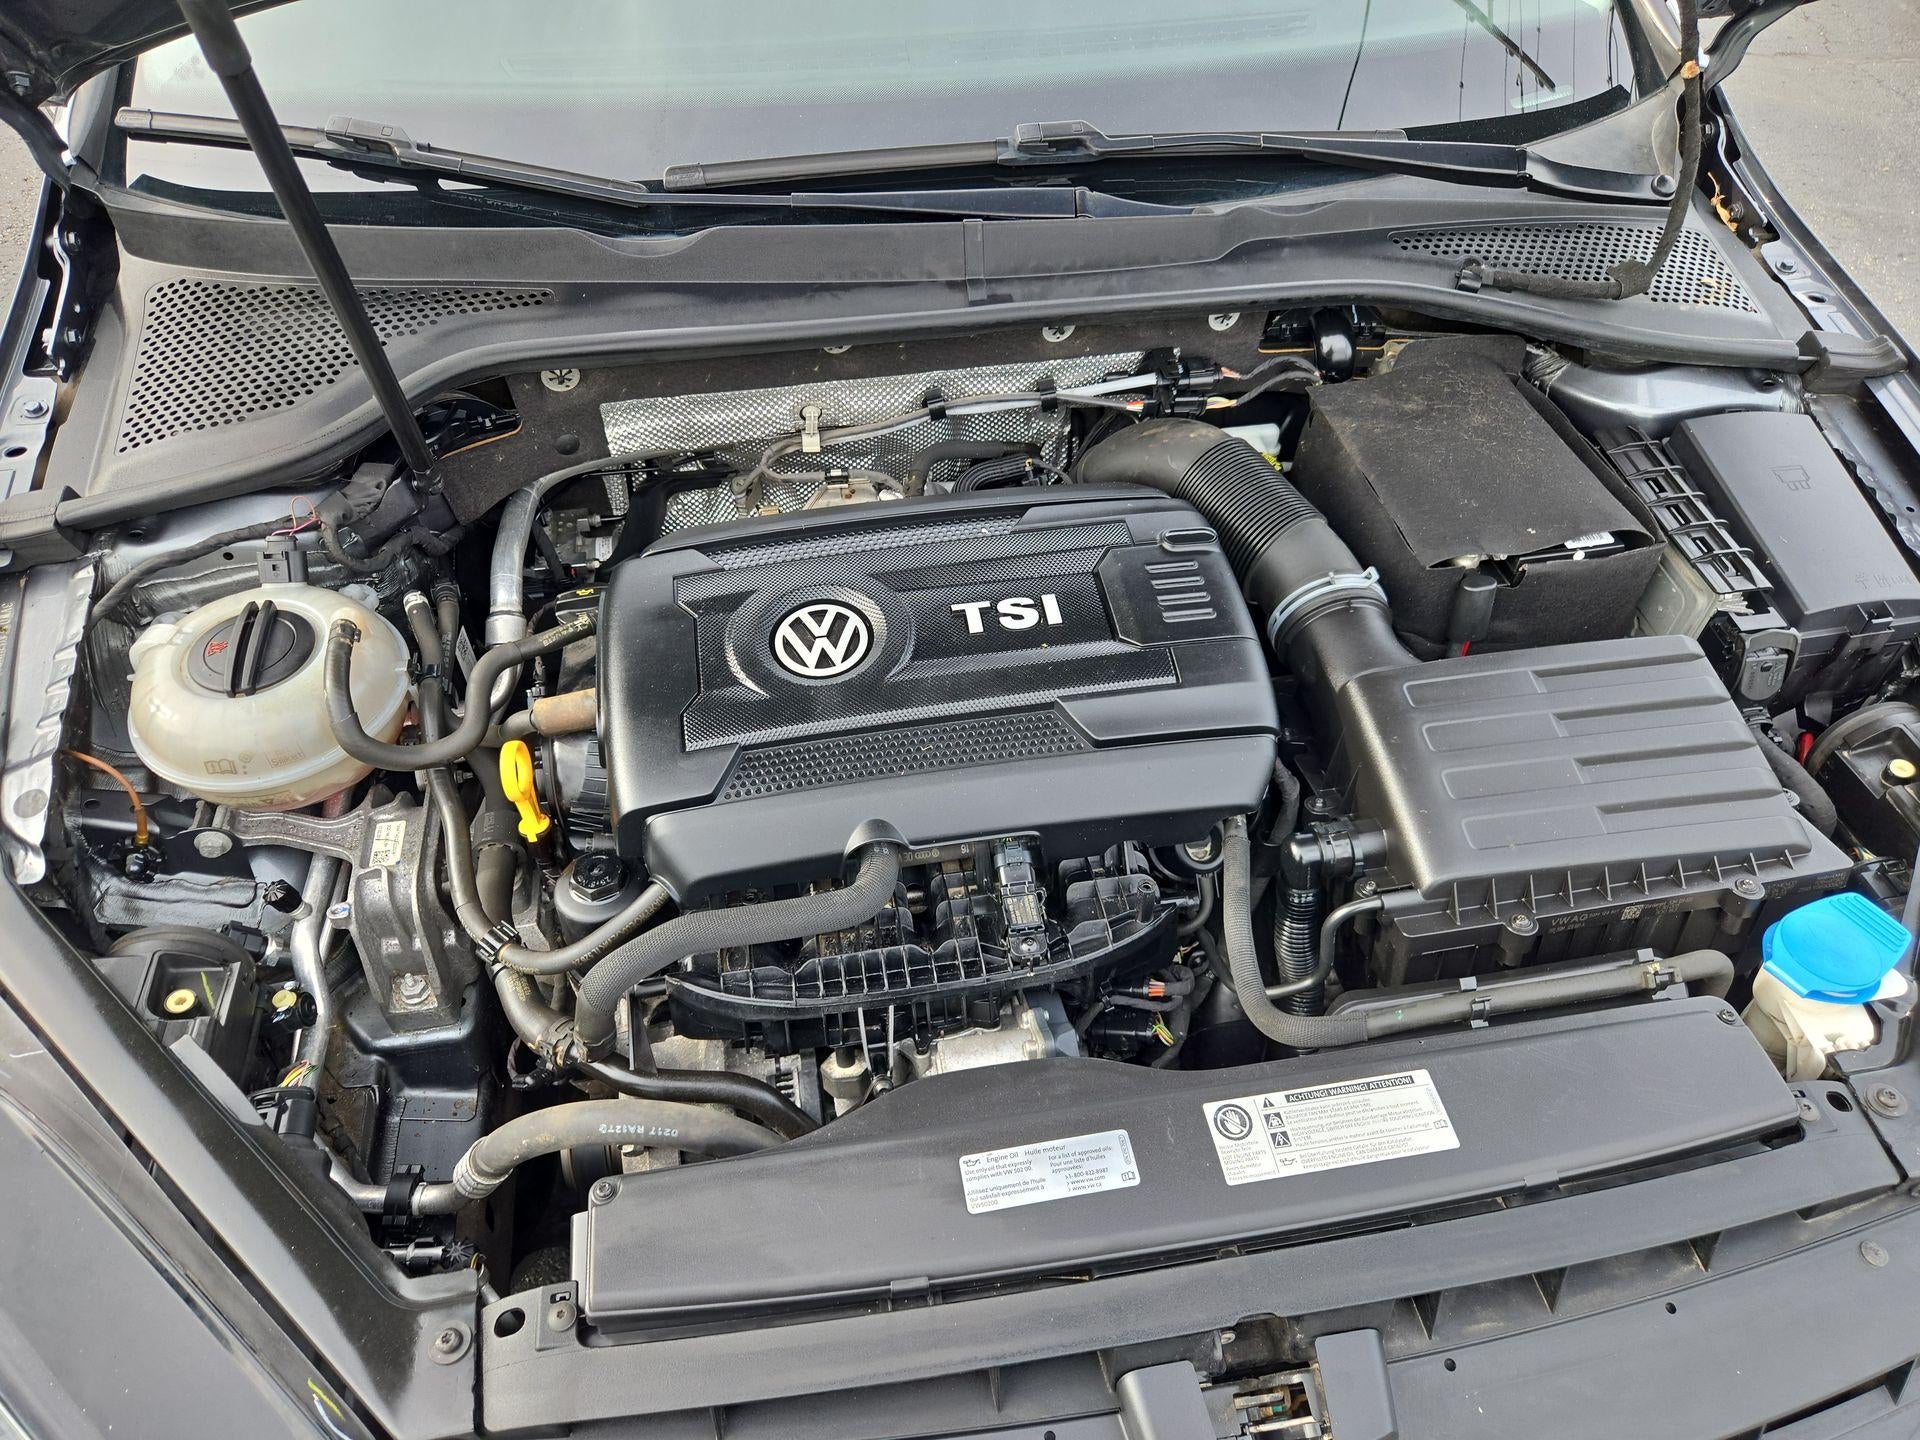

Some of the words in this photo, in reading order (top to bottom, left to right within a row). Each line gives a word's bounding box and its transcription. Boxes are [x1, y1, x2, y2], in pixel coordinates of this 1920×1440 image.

[951, 594, 1063, 634] TSI
[1288, 1089, 1327, 1101] ACHTUNG!
[1328, 1083, 1368, 1095] WARNING!
[1368, 1076, 1411, 1089] ATTENTION!
[986, 1153, 1008, 1164] Engine
[1024, 1148, 1041, 1156] Huile
[1042, 1144, 1065, 1153] moteur
